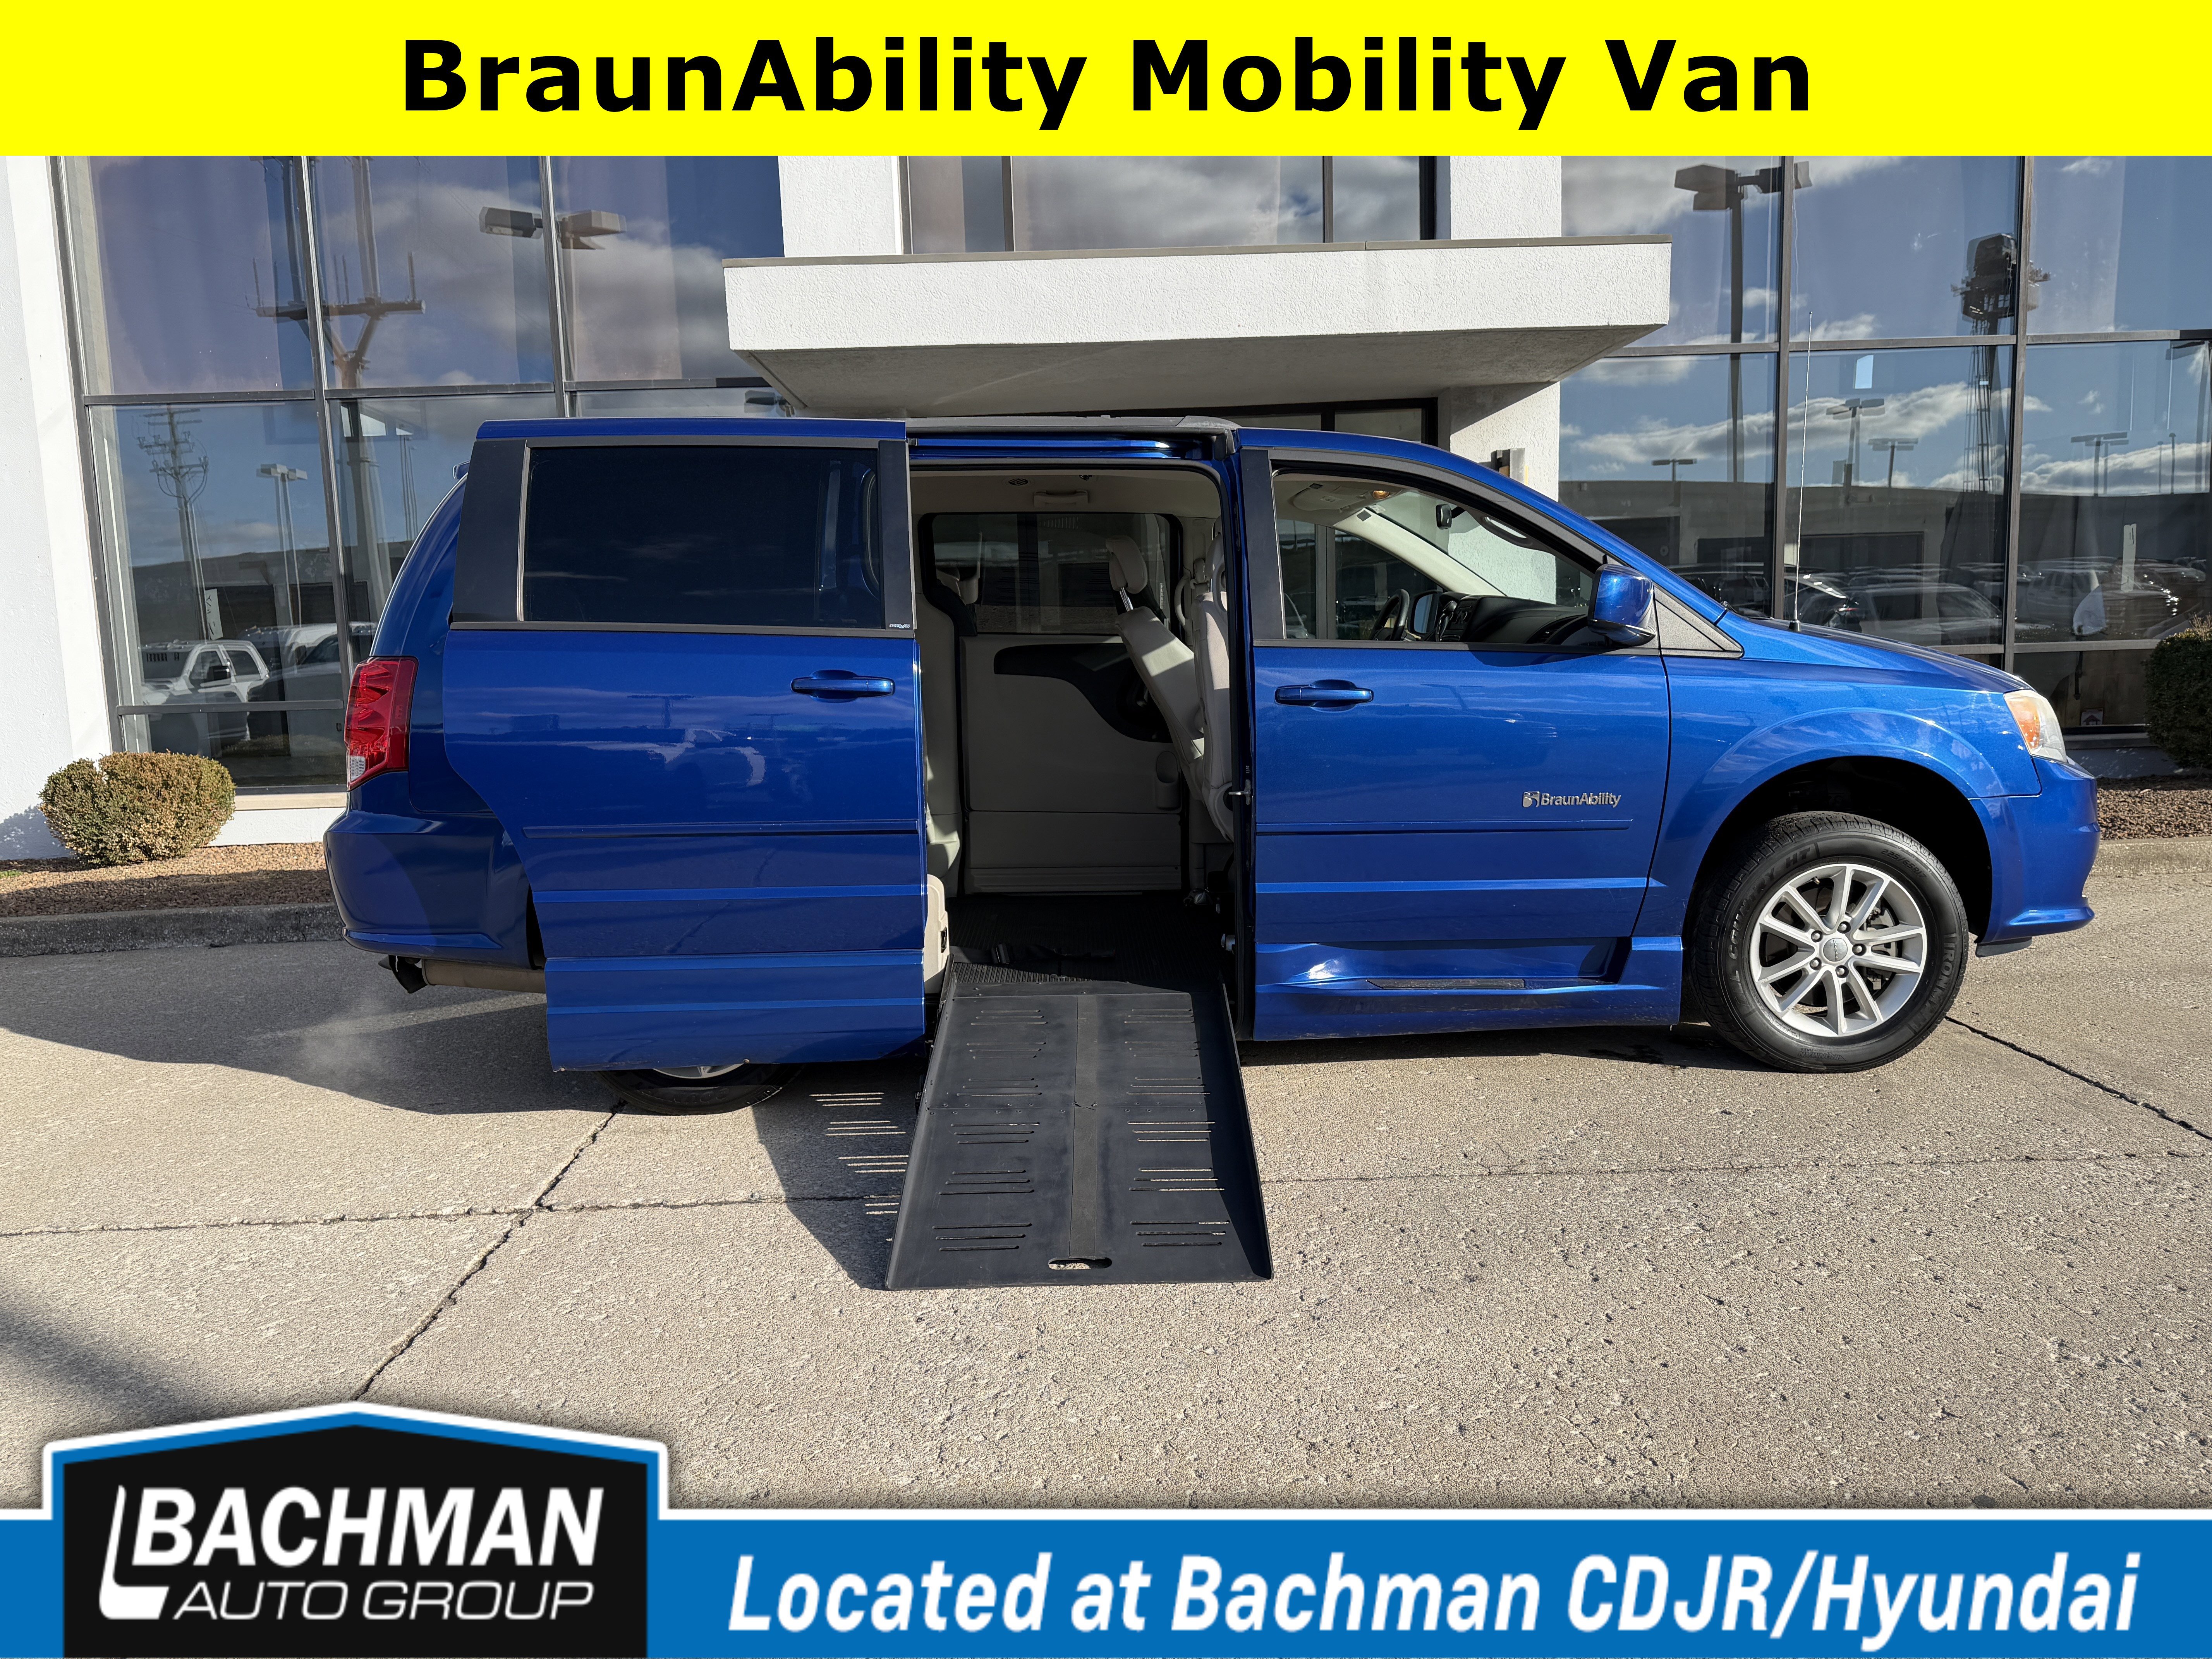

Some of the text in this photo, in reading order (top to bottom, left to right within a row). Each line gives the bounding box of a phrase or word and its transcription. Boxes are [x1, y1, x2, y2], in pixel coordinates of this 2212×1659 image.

[1540, 792, 1621, 808] BraunAbility
[1881, 849, 1927, 878] 225/65R17
[1728, 866, 1775, 960] COUNTRY
[1785, 847, 1811, 869] HT
[1910, 943, 1955, 1032] IRONMAN
